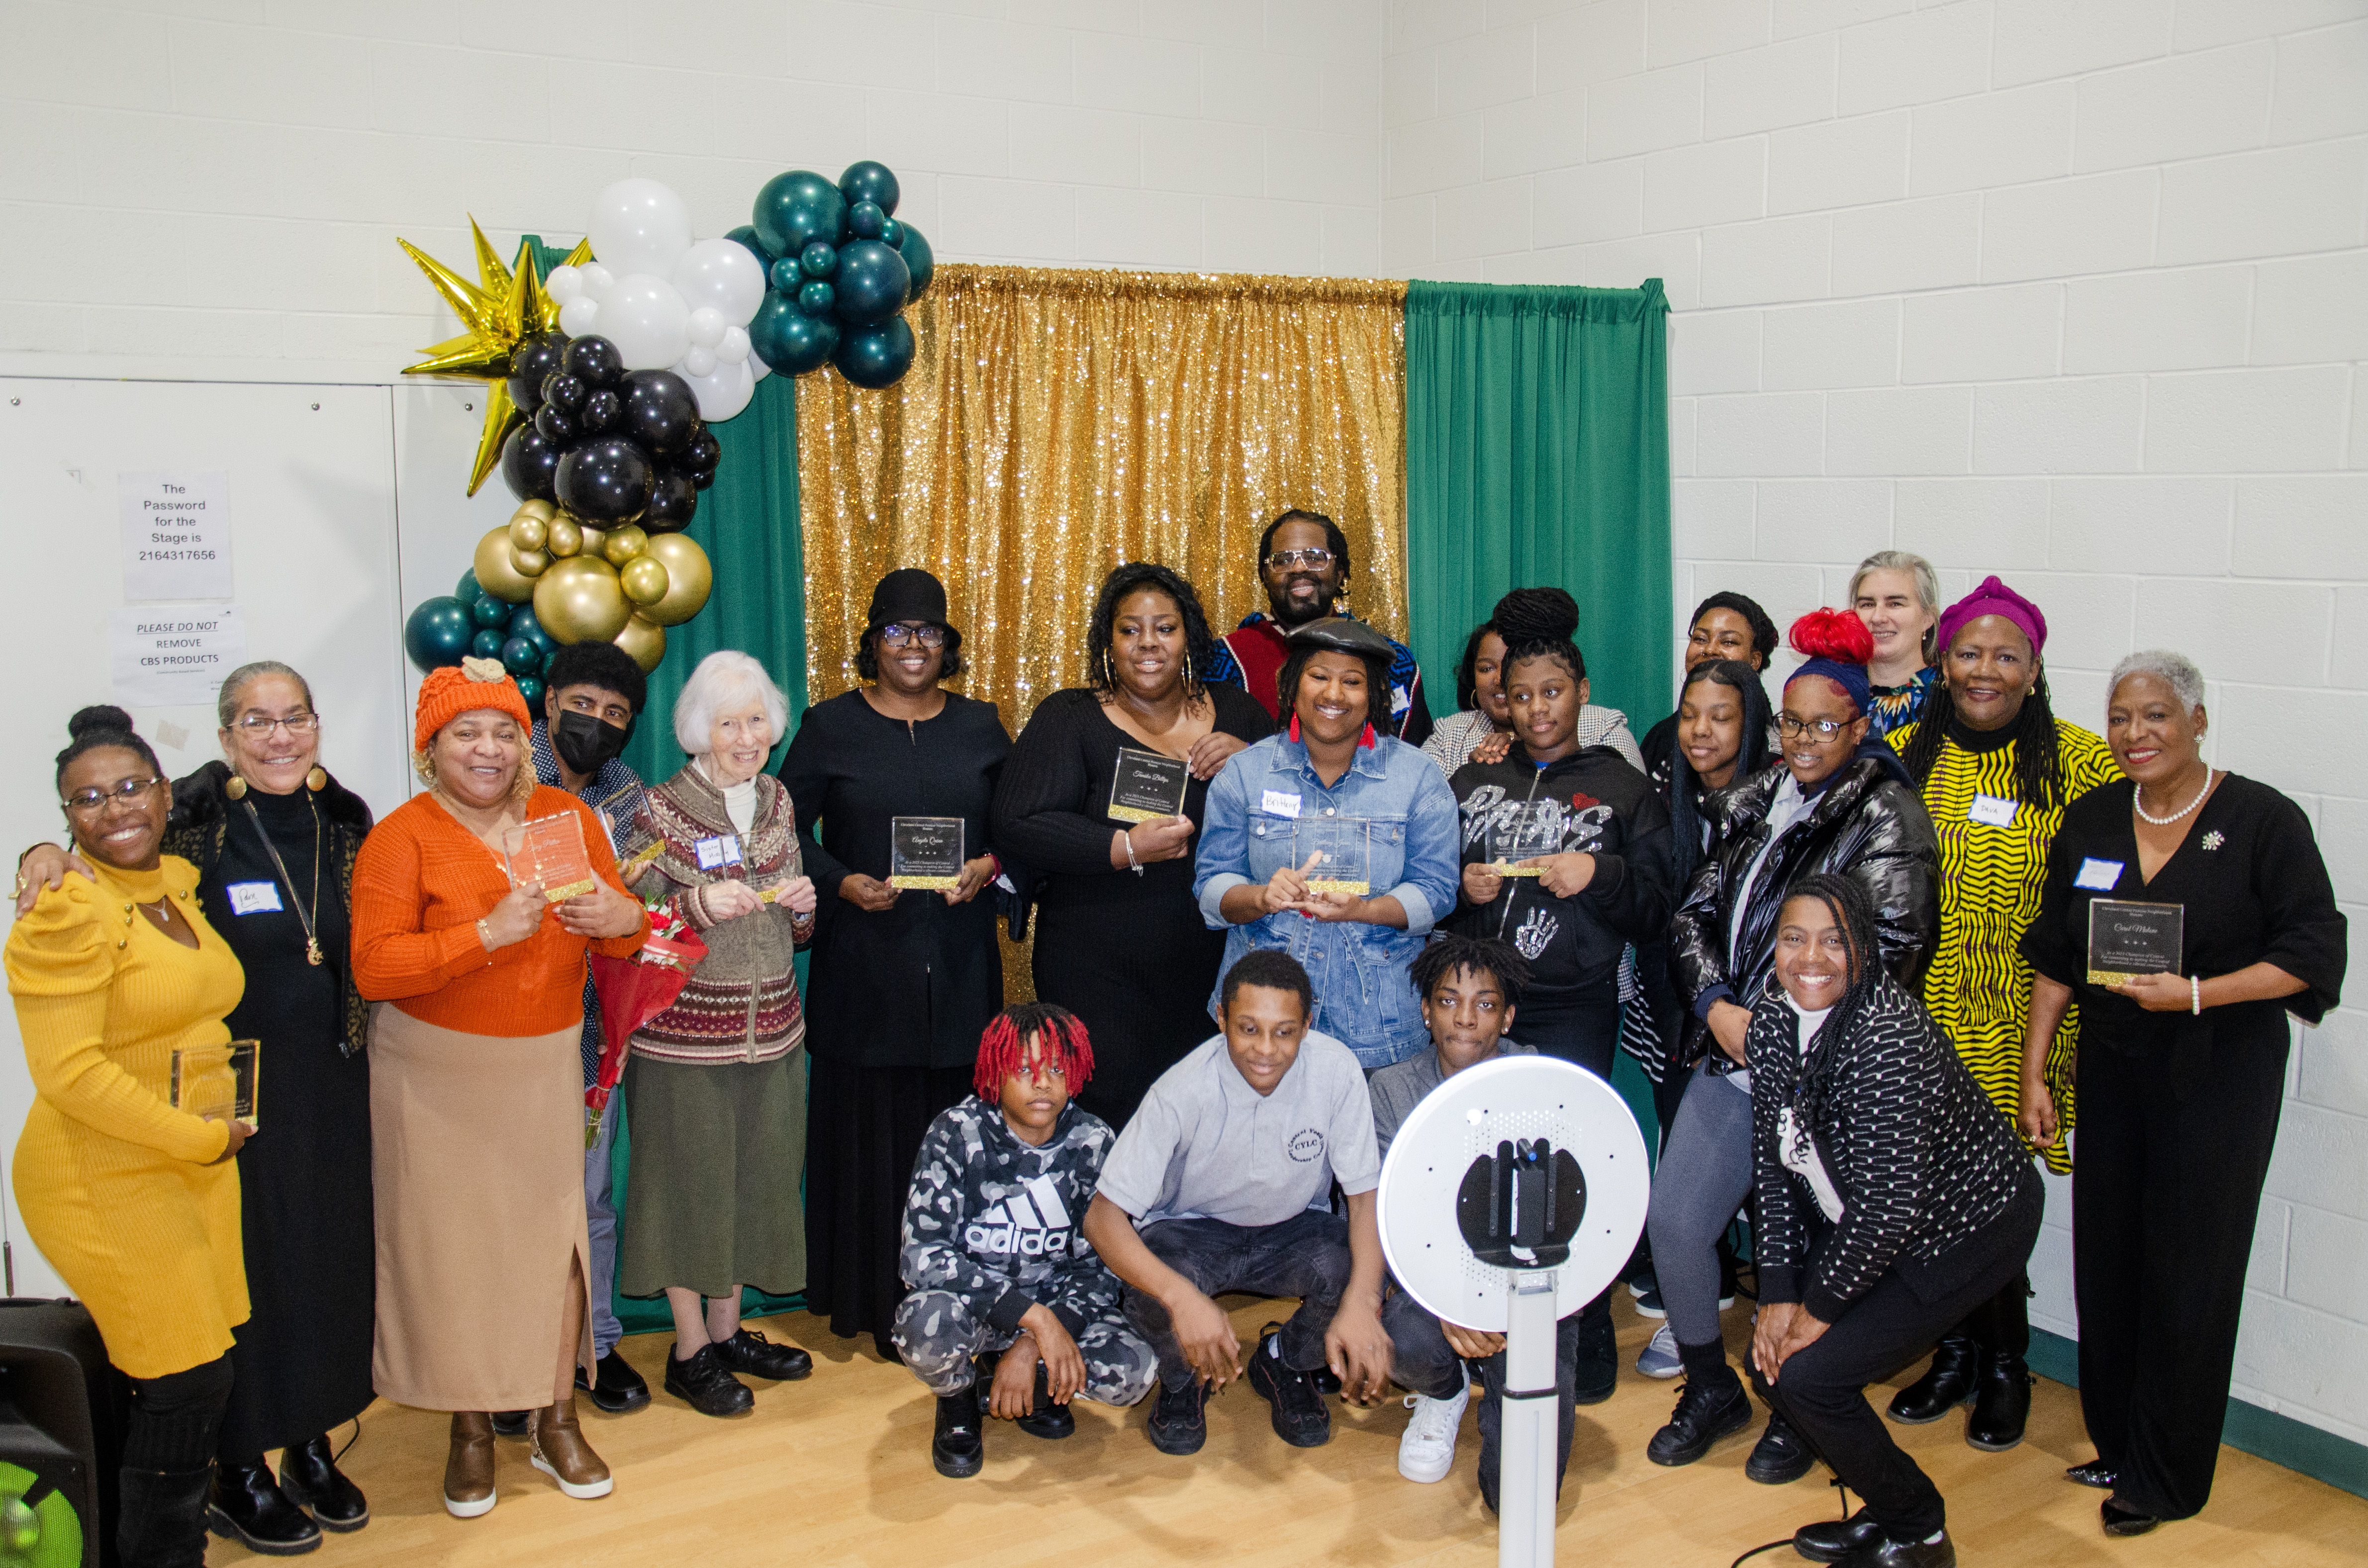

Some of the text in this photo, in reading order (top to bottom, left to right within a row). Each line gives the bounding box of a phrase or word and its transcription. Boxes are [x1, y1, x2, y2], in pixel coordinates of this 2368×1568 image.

[162, 484, 186, 494] The
[144, 500, 206, 510] Password
[155, 517, 196, 526] for the
[152, 533, 202, 545] Stage is
[139, 551, 216, 560] 2164317656
[137, 622, 219, 633] PLEASE DO NOT
[156, 639, 202, 648] REMOVE
[141, 654, 219, 666] CBS PRODUCTS
[1295, 1139, 1318, 1151] CYLC
[965, 1221, 1068, 1256] adida
